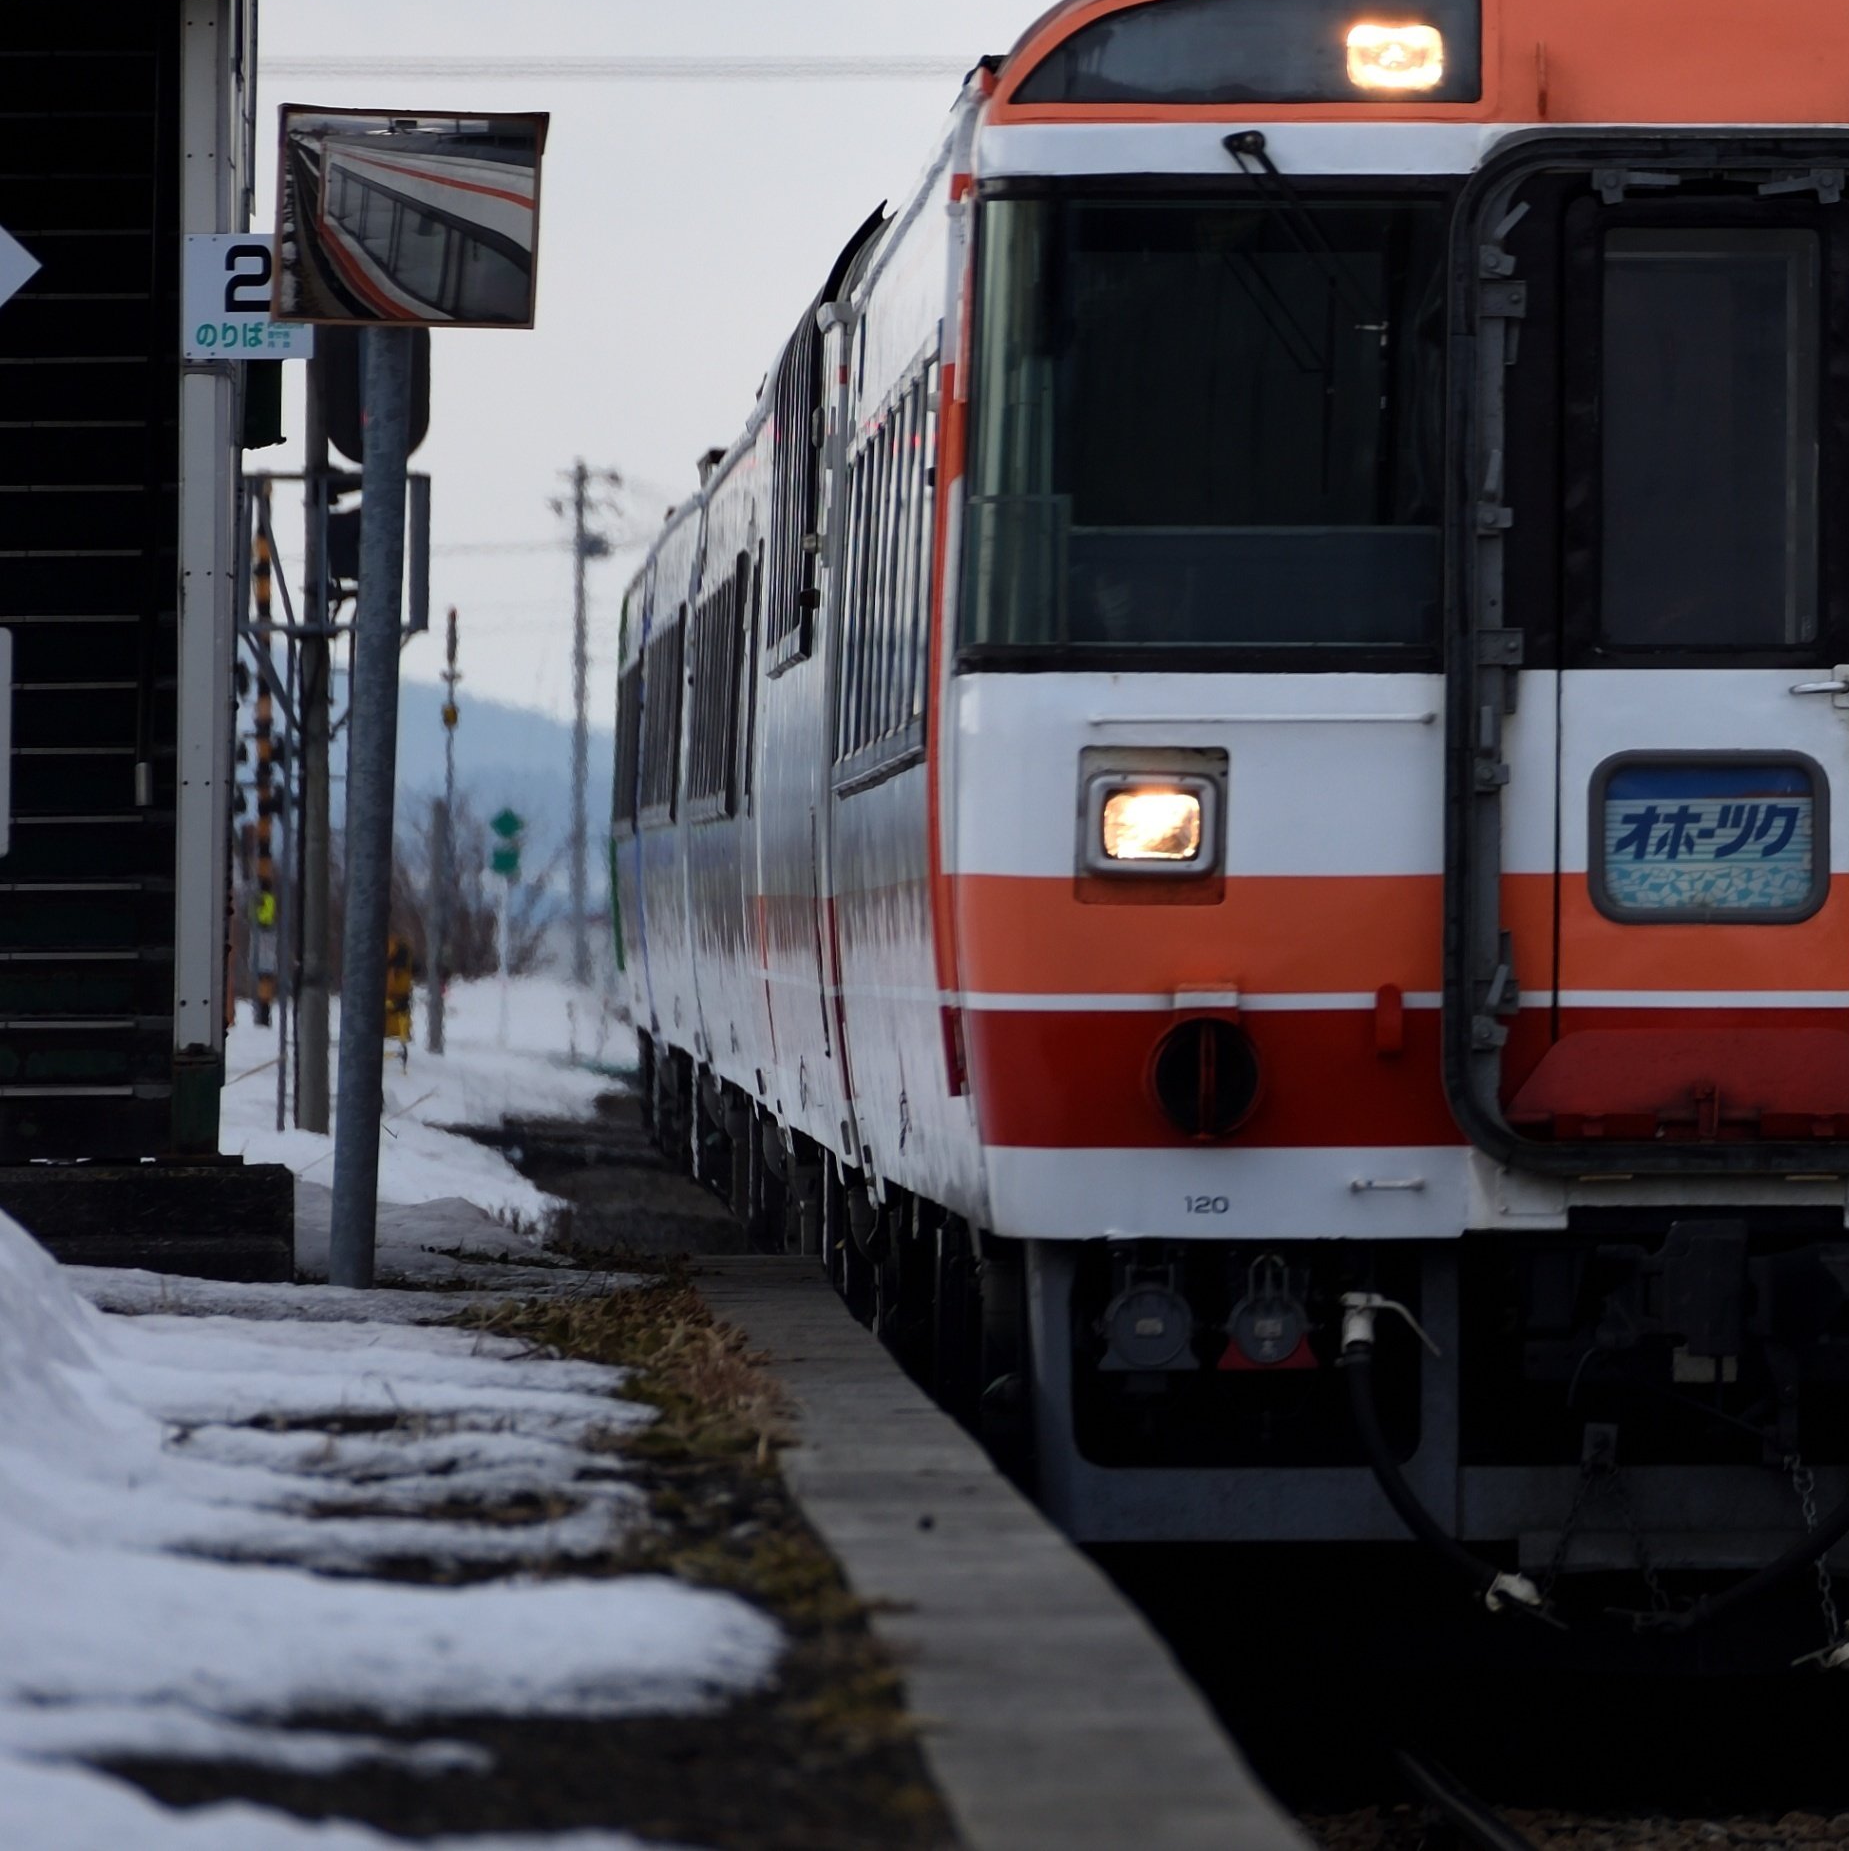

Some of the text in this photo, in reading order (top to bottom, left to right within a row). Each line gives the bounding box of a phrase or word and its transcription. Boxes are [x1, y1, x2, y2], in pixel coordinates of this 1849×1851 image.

[225, 244, 272, 313] 2
[195, 322, 264, 348] のりば
[1612, 804, 1800, 861] オホーツク
[1184, 1195, 1230, 1214] 120
